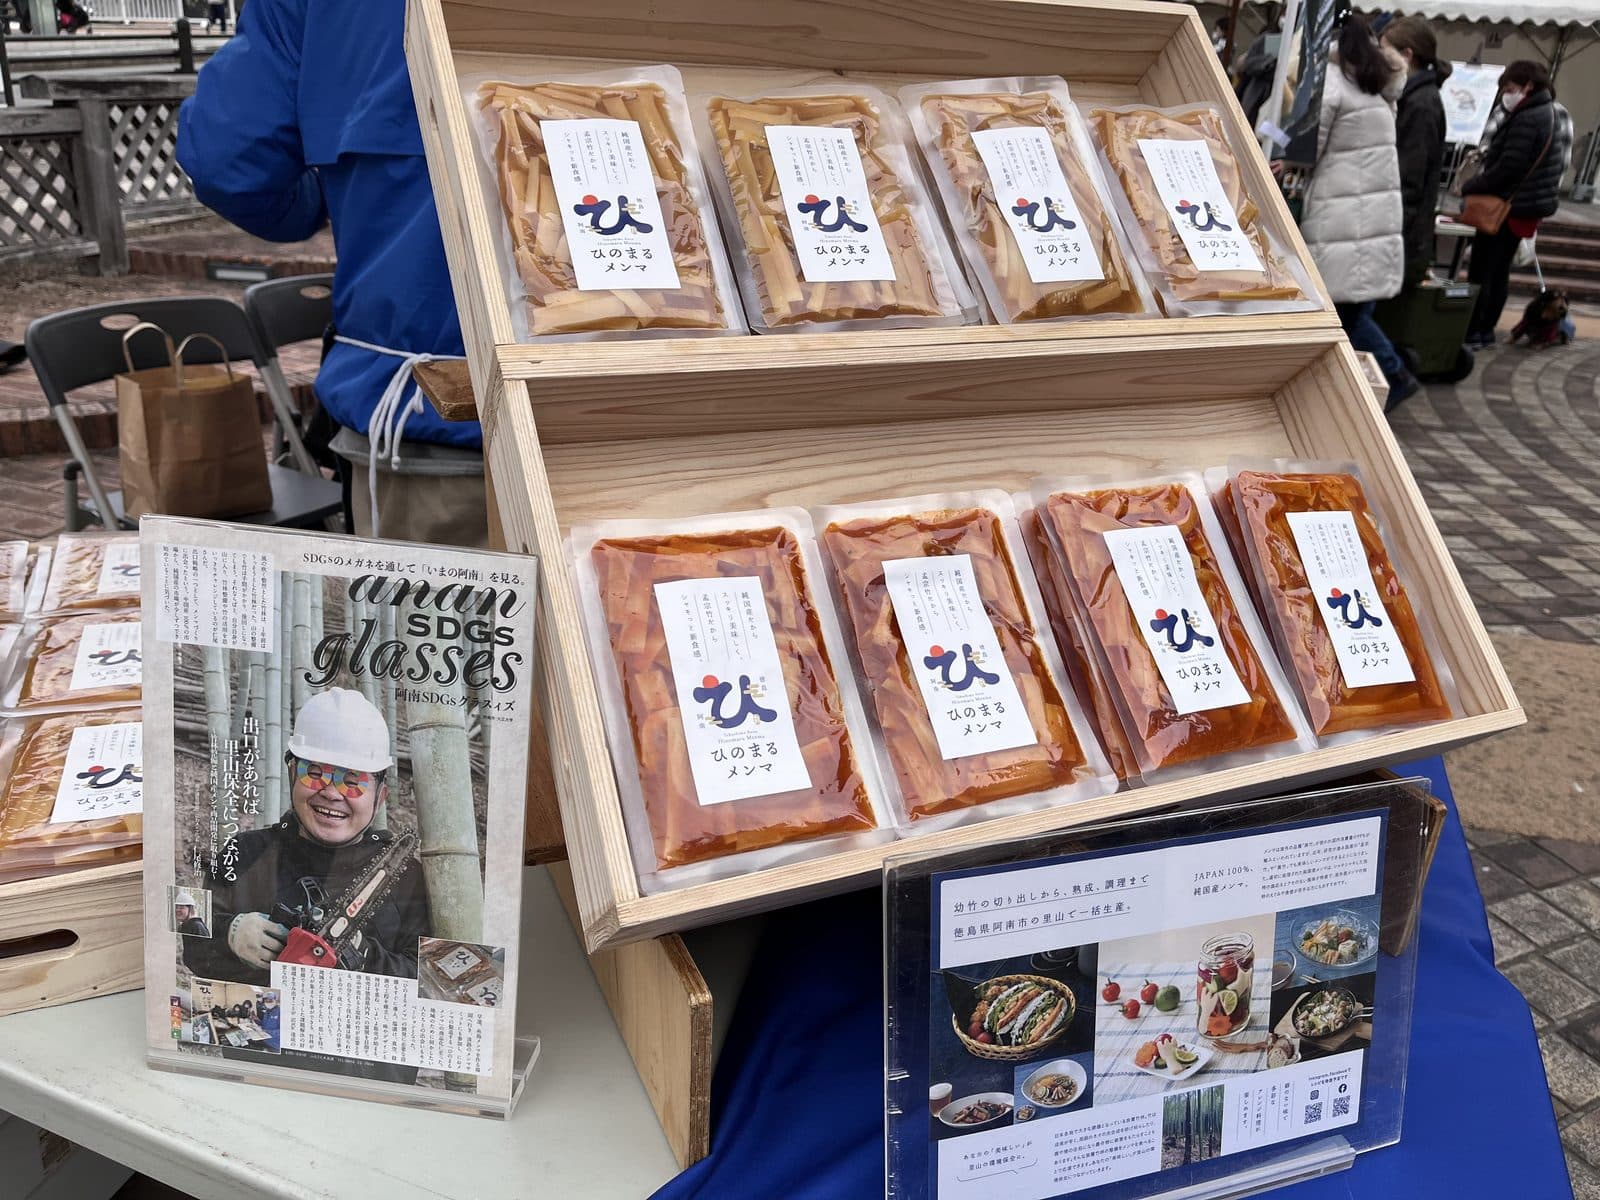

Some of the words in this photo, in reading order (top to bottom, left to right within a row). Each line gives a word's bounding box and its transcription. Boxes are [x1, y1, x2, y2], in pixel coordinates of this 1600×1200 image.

[590, 248, 653, 260] ひのまる
[814, 245, 870, 255] ひのまる
[1033, 242, 1081, 255] ひのまる
[604, 263, 648, 273] メンマ
[827, 257, 866, 267] メンマ
[1047, 257, 1079, 266] メンマ
[303, 552, 524, 586] SDGsのメガネを通して「いまの阿南」を見る。
[348, 574, 526, 618] anan
[304, 618, 523, 693] glasses
[1347, 642, 1391, 655] ひのまる
[1361, 658, 1390, 668] メンマ
[1175, 663, 1223, 680] ひのまる
[1193, 680, 1222, 693] メンマ
[946, 702, 1006, 721] ひのまる
[962, 721, 1003, 736] メンマ
[710, 741, 778, 762] ひのまる
[243, 717, 260, 815] 出口があれば
[727, 763, 774, 779] メンマ
[77, 790, 141, 805] ひのまる
[84, 800, 131, 812] メンマ
[223, 739, 240, 882] 里山保全につながる
[1194, 868, 1225, 882] JAPAN
[953, 874, 1150, 914] 幼竹の切り出しから、熟成、調理まで
[953, 902, 1131, 938] 徳島県阿南市の里山で一括生産。
